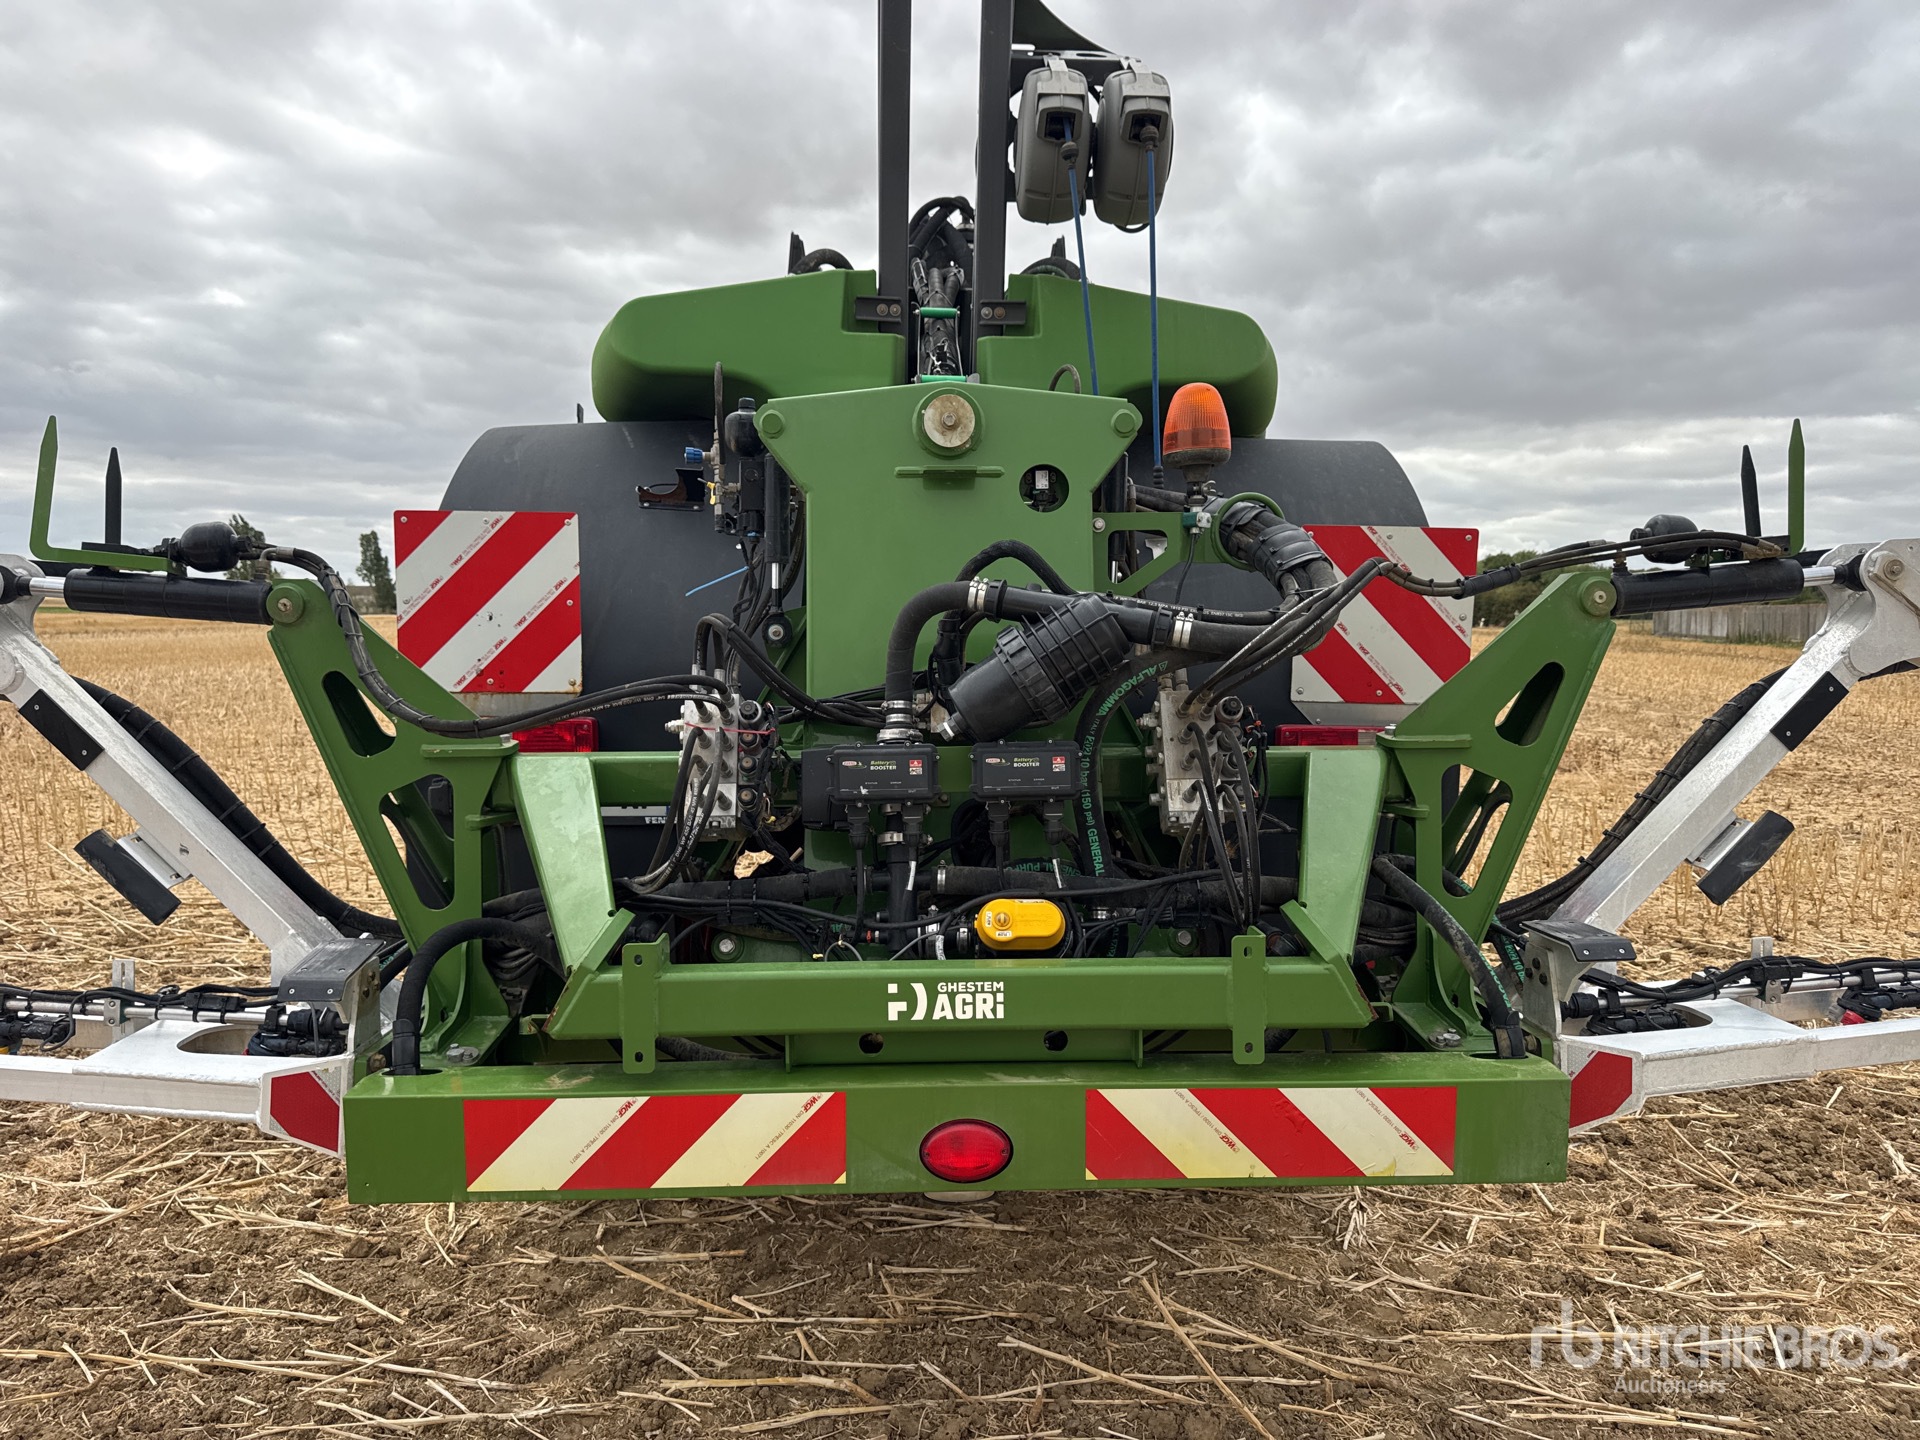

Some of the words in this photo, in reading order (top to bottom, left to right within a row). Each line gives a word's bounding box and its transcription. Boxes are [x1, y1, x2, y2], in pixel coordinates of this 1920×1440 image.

[1096, 664, 1157, 716] ALFAGOMMA
[1080, 757, 1090, 768] 10
[1080, 770, 1090, 786] bar
[1081, 789, 1092, 810] (150
[1083, 811, 1095, 826] psi)
[1087, 828, 1105, 877] GENERAL
[937, 981, 1004, 993] GHESTEM
[617, 1101, 633, 1117] WGF
[802, 1096, 818, 1112] WGF
[1219, 1134, 1235, 1149] WGF
[1399, 1132, 1415, 1147] WGF
